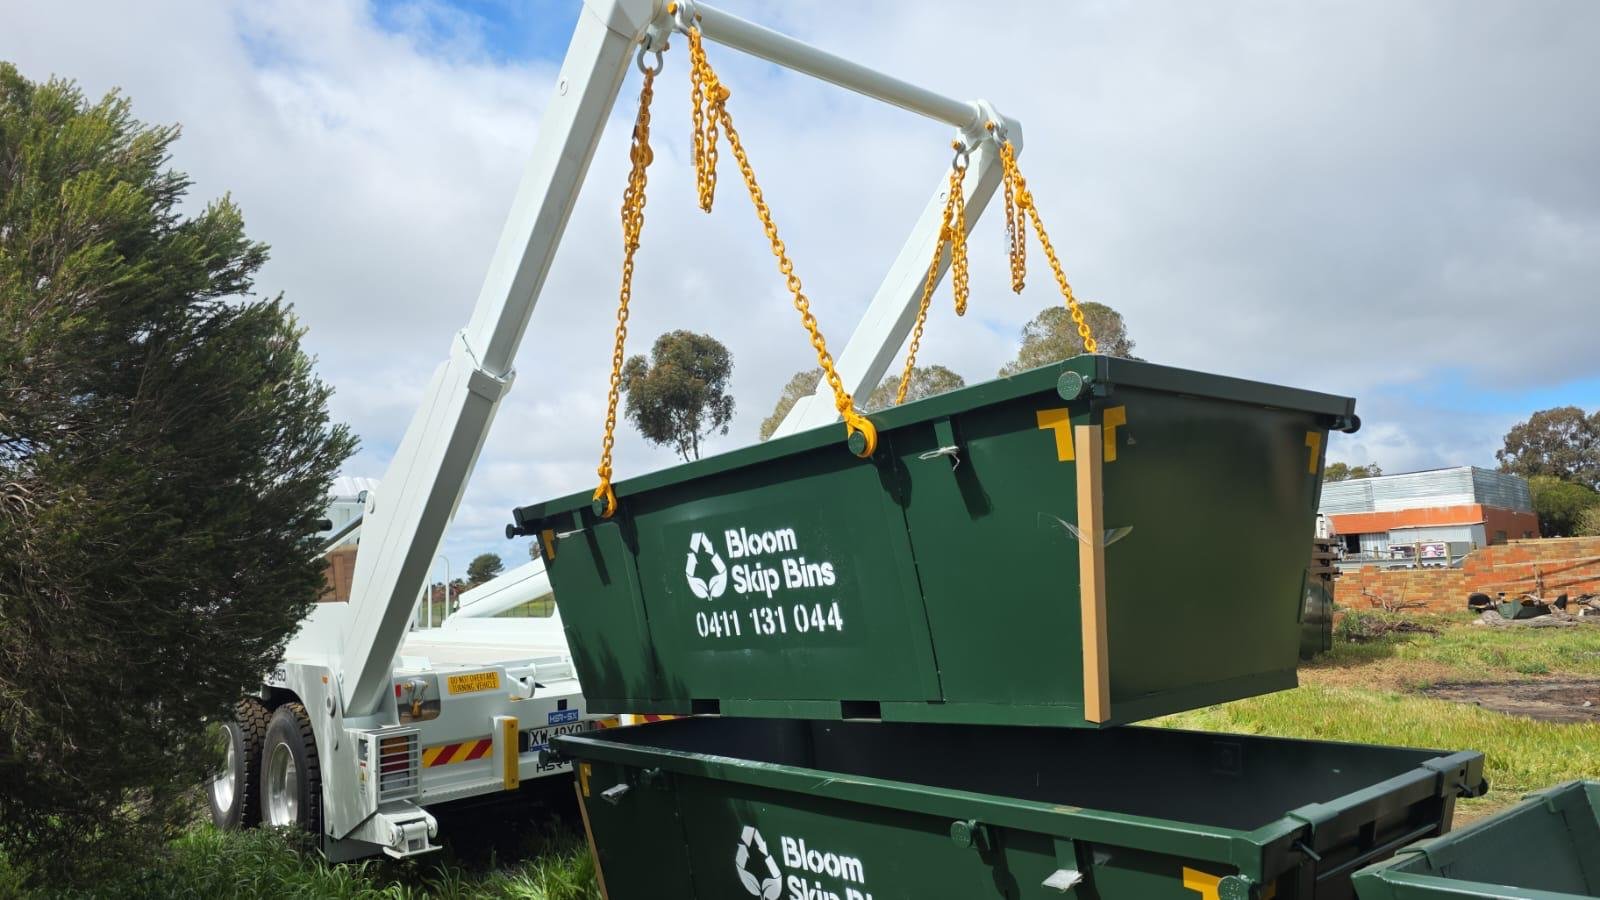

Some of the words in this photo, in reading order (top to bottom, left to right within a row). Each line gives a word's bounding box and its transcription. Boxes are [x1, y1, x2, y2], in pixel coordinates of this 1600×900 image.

[725, 527, 798, 558] Bloom
[731, 562, 780, 598] Skip
[782, 556, 836, 589] Bins
[696, 610, 741, 638] 0411
[749, 606, 787, 635] 131
[793, 602, 843, 632] 044
[781, 836, 864, 884] Bloom
